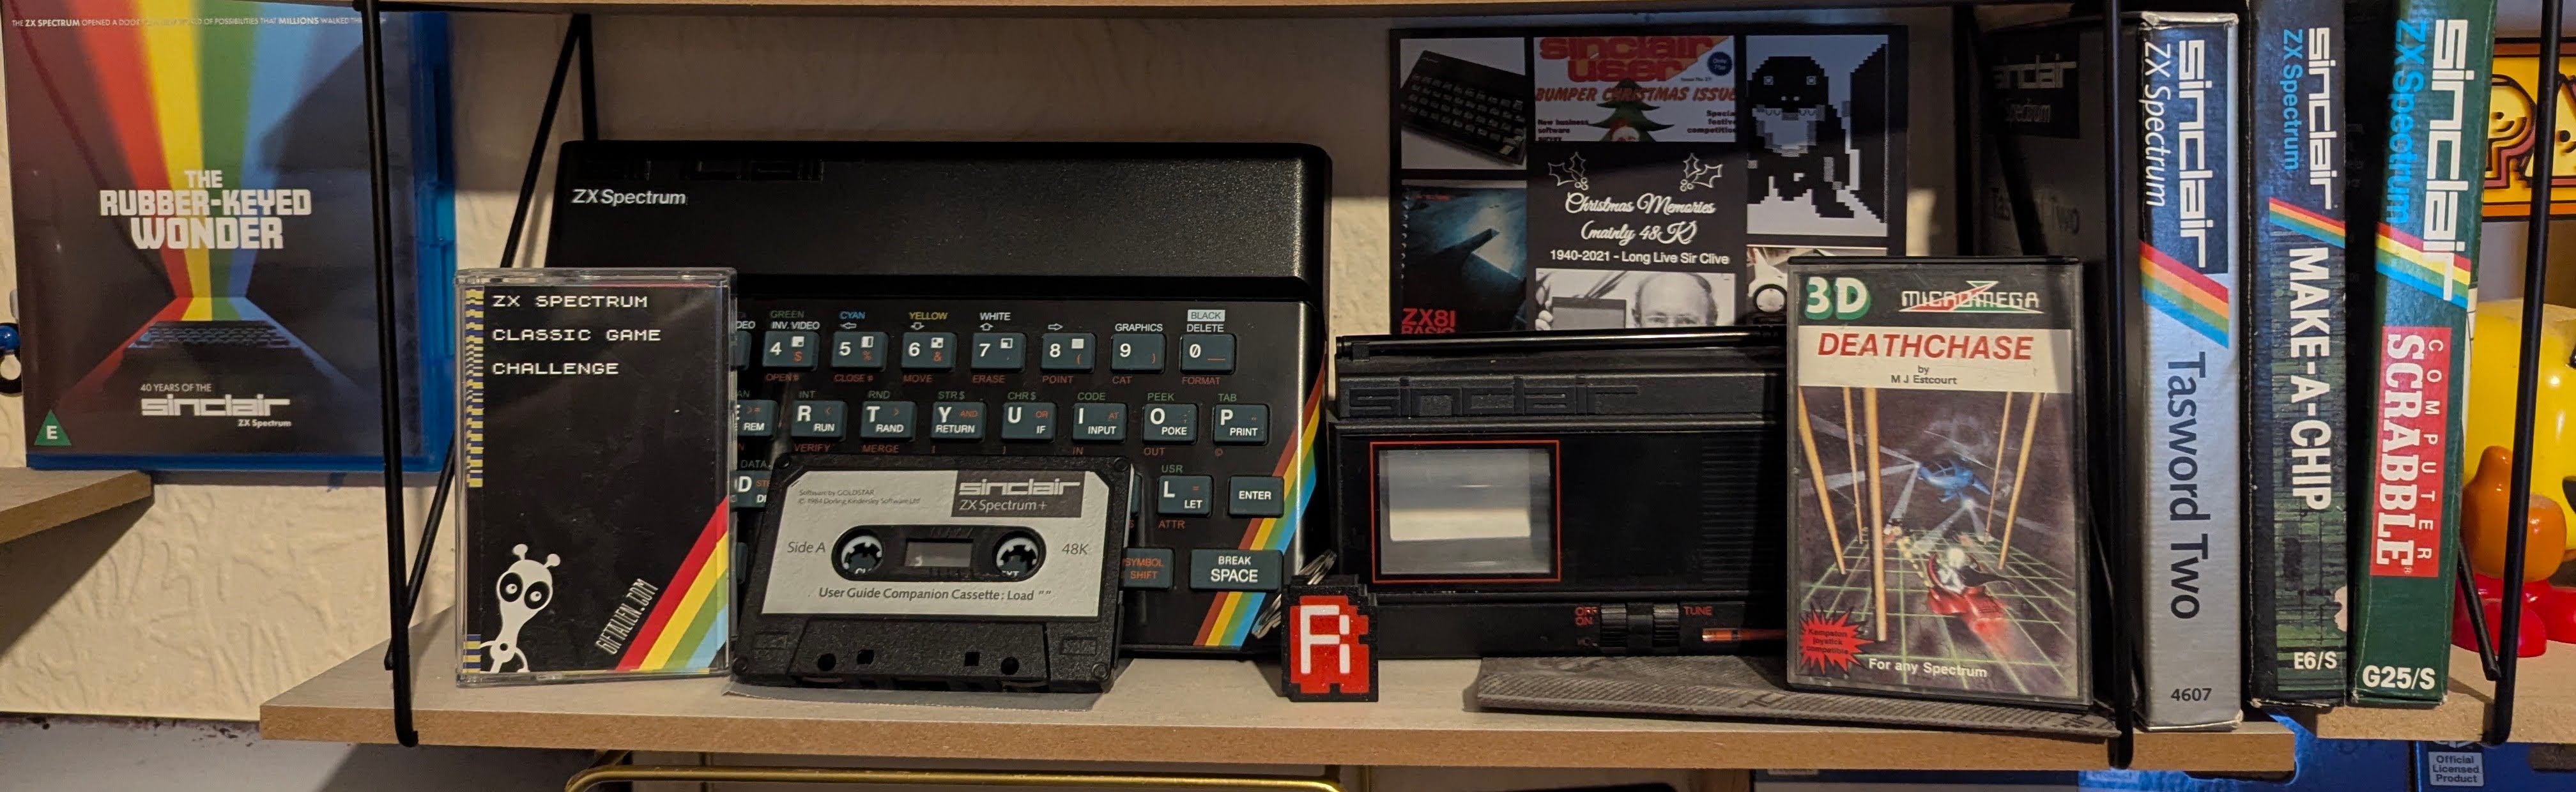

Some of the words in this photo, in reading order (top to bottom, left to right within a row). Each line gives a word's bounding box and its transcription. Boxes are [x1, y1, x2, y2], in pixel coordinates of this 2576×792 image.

[1540, 37, 1713, 59] sinclair
[2283, 29, 2303, 59] ZX
[2394, 19, 2426, 64] ZX
[2144, 40, 2171, 78] ZX
[1568, 59, 1682, 82] user
[1535, 88, 1596, 101] BUMPER
[1602, 87, 1690, 101] CHRISTMAS
[1692, 88, 1737, 102] ISSUE
[2279, 65, 2303, 171] Spectrum
[2308, 27, 2337, 209] sinclair
[2139, 84, 2172, 208] Spectrum
[2386, 70, 2425, 223] Spectrum
[2179, 40, 2214, 268] sinclair
[2423, 19, 2474, 301] sinclair
[184, 170, 222, 188] THE
[100, 189, 311, 216] RUBBER-KEYED
[572, 189, 598, 204] ZX
[601, 189, 687, 207] Spectrum
[1565, 192, 1634, 213] Christmas
[1636, 193, 1717, 215] Memories
[130, 217, 283, 249] WONDER
[1581, 220, 1636, 246] (mainly
[1639, 220, 1698, 245] 48K)
[1551, 250, 1610, 261] 1940-2021
[1622, 251, 1652, 264] Long
[1653, 252, 1678, 263] Live
[1680, 252, 1698, 263] Sir
[1699, 253, 1731, 264] Clive
[492, 295, 521, 308] ZX
[535, 295, 648, 308] SPECTRUM
[1805, 276, 1871, 319] 3D
[1901, 290, 2040, 308] MICROMEGA
[839, 311, 866, 319] CYAN
[980, 312, 1011, 321] WHITE
[1402, 308, 1456, 328] ZX81
[772, 321, 790, 330] INV.
[792, 321, 820, 330] VIDEO
[1115, 323, 1163, 331] GRAPHICS
[1186, 324, 1224, 332] DELETE
[492, 329, 592, 342] CLASSIC
[606, 329, 661, 342] GAME
[770, 342, 782, 356] 4
[838, 342, 851, 356] 5
[908, 342, 921, 356] 6
[979, 343, 990, 357] 7
[1049, 343, 1061, 358] 8
[1120, 343, 1131, 357] 9
[1189, 344, 1201, 358] 0
[1818, 333, 2034, 360] DEATHCHASE
[492, 363, 619, 375] CHALLENGE
[1917, 365, 1929, 375] by
[972, 375, 1006, 383] ERASE
[1042, 375, 1074, 383] POINT
[1890, 375, 1901, 383] M
[1913, 374, 1958, 385] Estcourt
[2289, 247, 2332, 510] MAKE-A-CHIP
[799, 390, 815, 399] INT
[868, 391, 890, 399] RND
[1078, 392, 1106, 400] CODE
[1147, 393, 1174, 401] PEEK
[1218, 393, 1237, 402] TAB
[1348, 376, 1638, 416] sinclair
[141, 393, 290, 416] sinclair
[797, 405, 811, 422] R
[866, 406, 880, 423] T
[939, 407, 952, 423] Y
[1008, 407, 1022, 423] U
[1150, 407, 1165, 425] O
[1220, 409, 1233, 425] P
[252, 419, 291, 429] Spectrum
[744, 422, 765, 430] REM
[813, 423, 834, 432] RUN
[876, 424, 904, 432] RAND
[935, 424, 975, 433] RETURN
[1036, 425, 1046, 434] IF
[1087, 426, 1117, 434] INPUT
[47, 426, 57, 439] E
[1162, 427, 1187, 436] POKE
[1229, 427, 1258, 436] PRINT
[2167, 351, 2211, 521] Tasword
[794, 443, 830, 452] VERIFY
[862, 445, 900, 453] MERGE
[1073, 446, 1084, 455] IN
[1144, 447, 1165, 456] OUT
[741, 460, 767, 468] DATA
[1162, 464, 1183, 473] USR
[959, 478, 1080, 496] sinclair
[1163, 481, 1175, 498] L
[1238, 491, 1271, 500] ENTER
[959, 499, 977, 510] ZX
[1184, 499, 1203, 509] LET
[1158, 520, 1186, 529] ATTR
[787, 542, 814, 553] Side
[816, 542, 826, 552] A
[1062, 544, 1089, 555] 48K
[1124, 558, 1164, 567] SYMBOL
[1218, 556, 1251, 565] BREAK
[1130, 570, 1158, 579] SHIFT
[1211, 569, 1259, 583] SPACE
[2170, 534, 2209, 619] Two
[818, 588, 845, 598] User
[847, 588, 880, 598] Guide
[883, 588, 949, 601] Companion
[1007, 590, 1034, 600] Load
[595, 578, 658, 655] GIFTALIEN.COM
[1574, 607, 1597, 616] OFF
[1683, 605, 1713, 616] TUNE
[1575, 617, 1594, 626] ON
[1300, 605, 1351, 674] R
[1809, 628, 1848, 638] Kempston
[1813, 637, 1843, 646] joystick
[1806, 645, 1848, 655] compatible
[2294, 651, 2337, 669] E6/S
[1868, 659, 1891, 670] For
[1895, 662, 1918, 674] any
[1923, 662, 1988, 678] Spectrum
[2362, 666, 2435, 690] G25/S
[2171, 687, 2212, 702] 4607
[2436, 755, 2474, 764] Official
[2433, 765, 2480, 774] Licensed
[2436, 774, 2478, 784] Product
